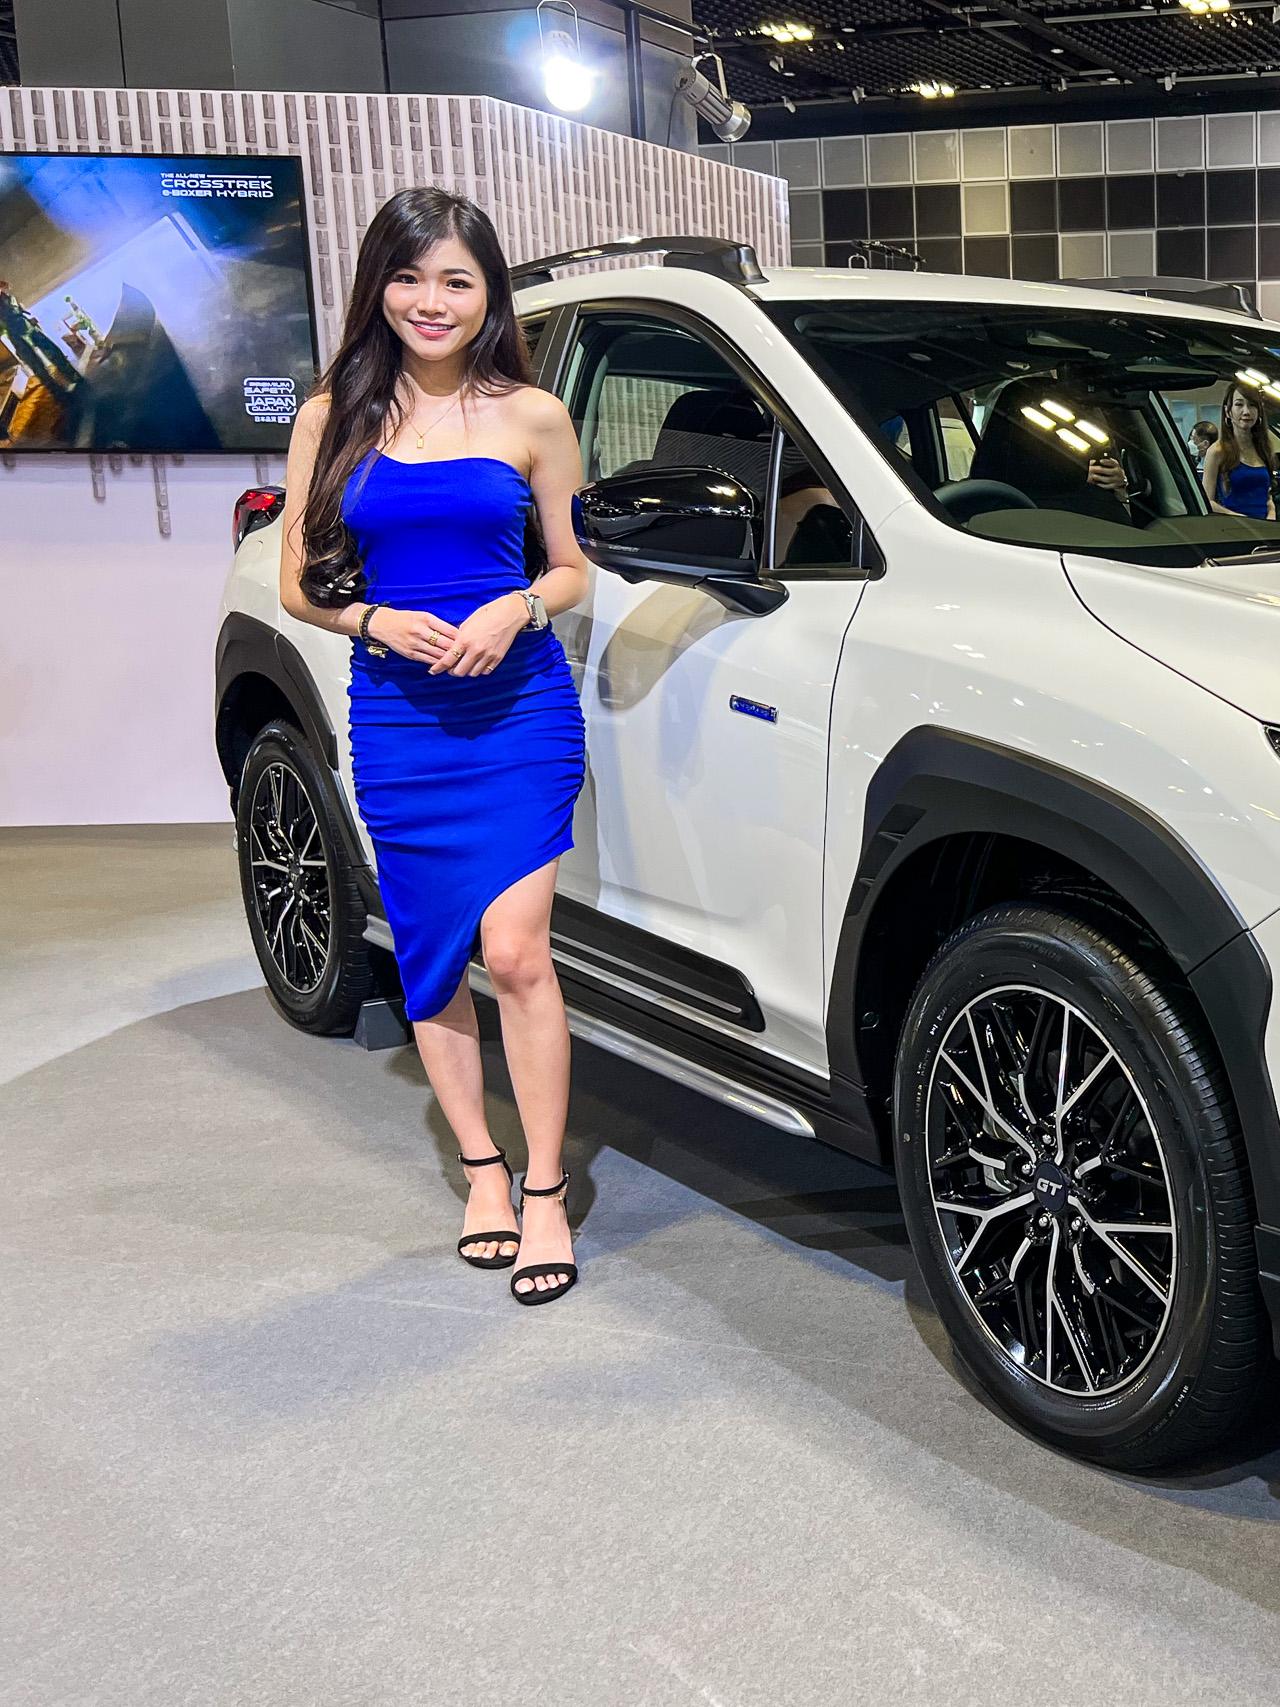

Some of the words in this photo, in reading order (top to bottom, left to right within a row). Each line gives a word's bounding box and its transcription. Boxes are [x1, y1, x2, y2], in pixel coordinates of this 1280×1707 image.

[161, 179, 273, 190] CROSSTREK
[162, 189, 213, 198] e-BOXER
[216, 190, 274, 198] HYBRID
[246, 396, 297, 407] JAPAN
[1036, 1177, 1063, 1196] GT
